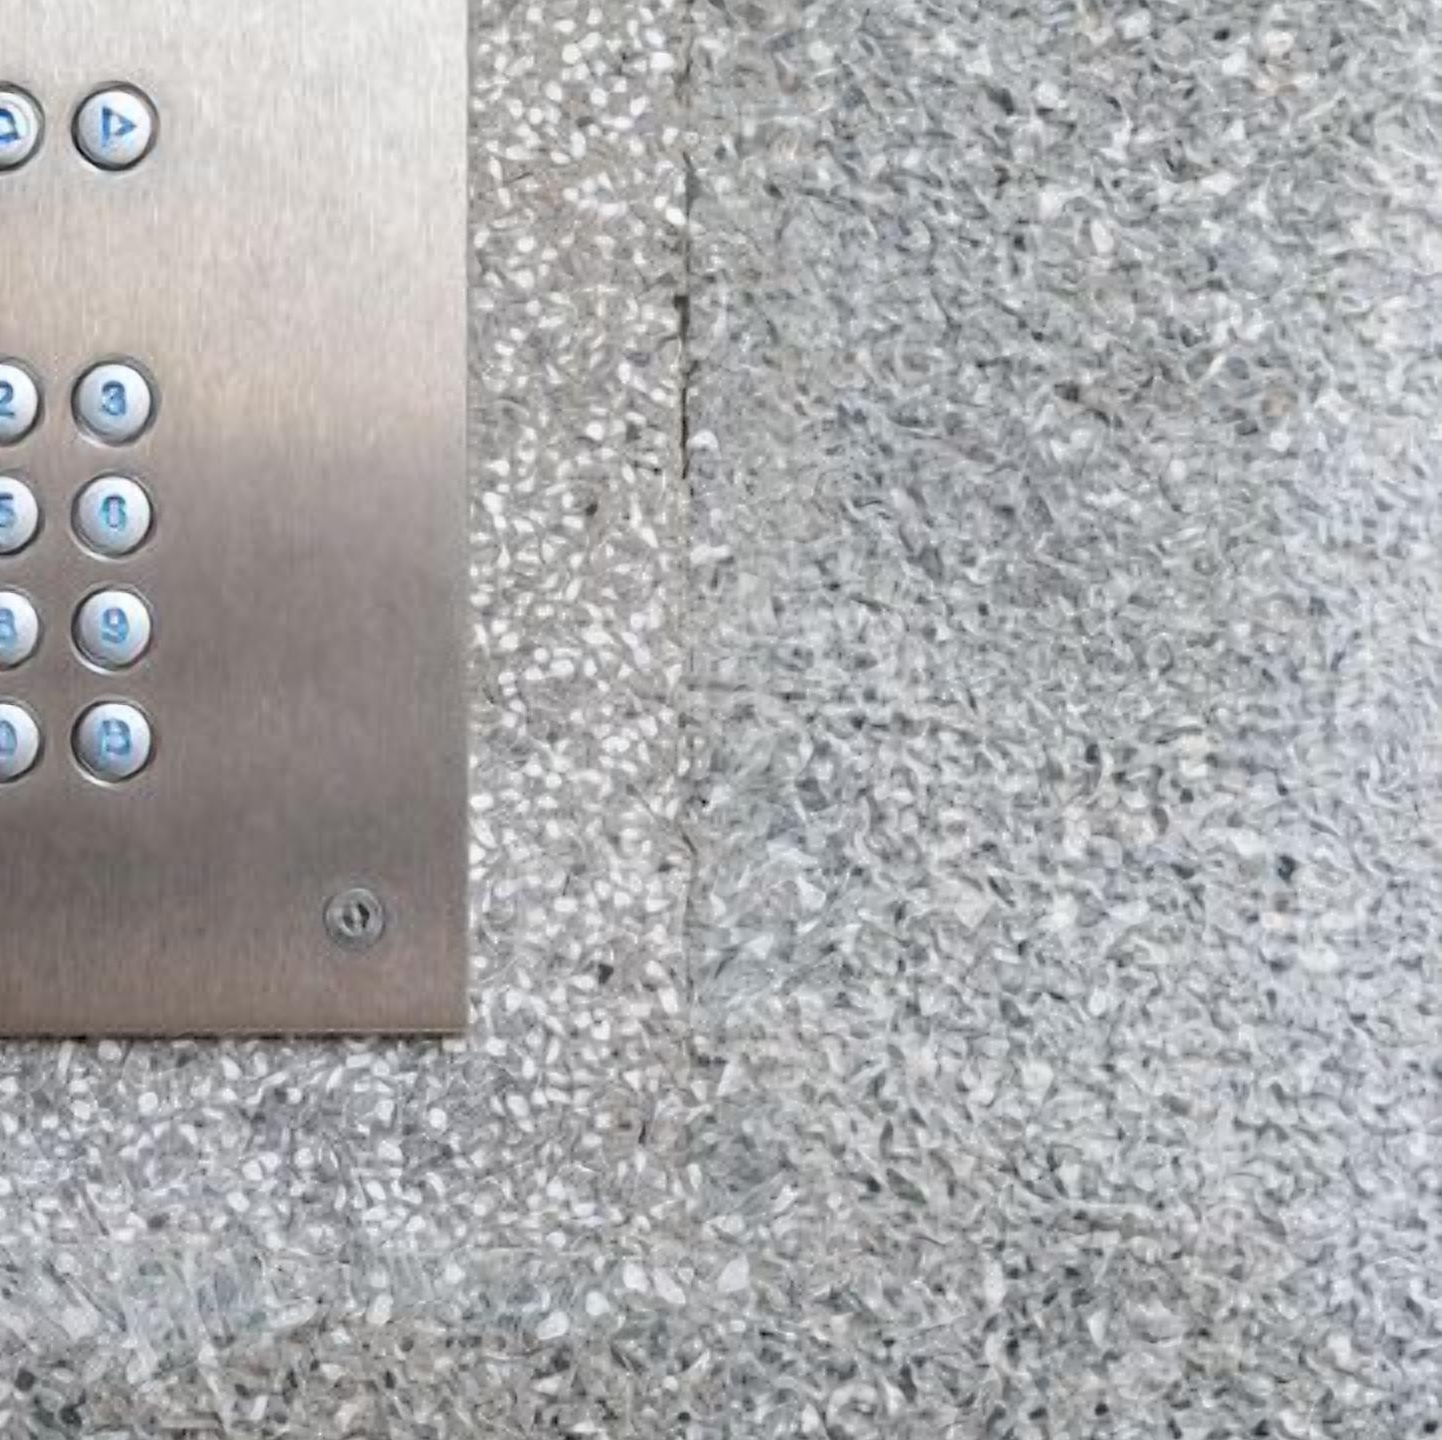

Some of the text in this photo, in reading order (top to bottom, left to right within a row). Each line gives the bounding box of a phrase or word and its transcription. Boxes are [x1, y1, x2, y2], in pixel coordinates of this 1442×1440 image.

[100, 380, 127, 418] 3
[100, 606, 130, 643] 9
[100, 718, 132, 757] B
